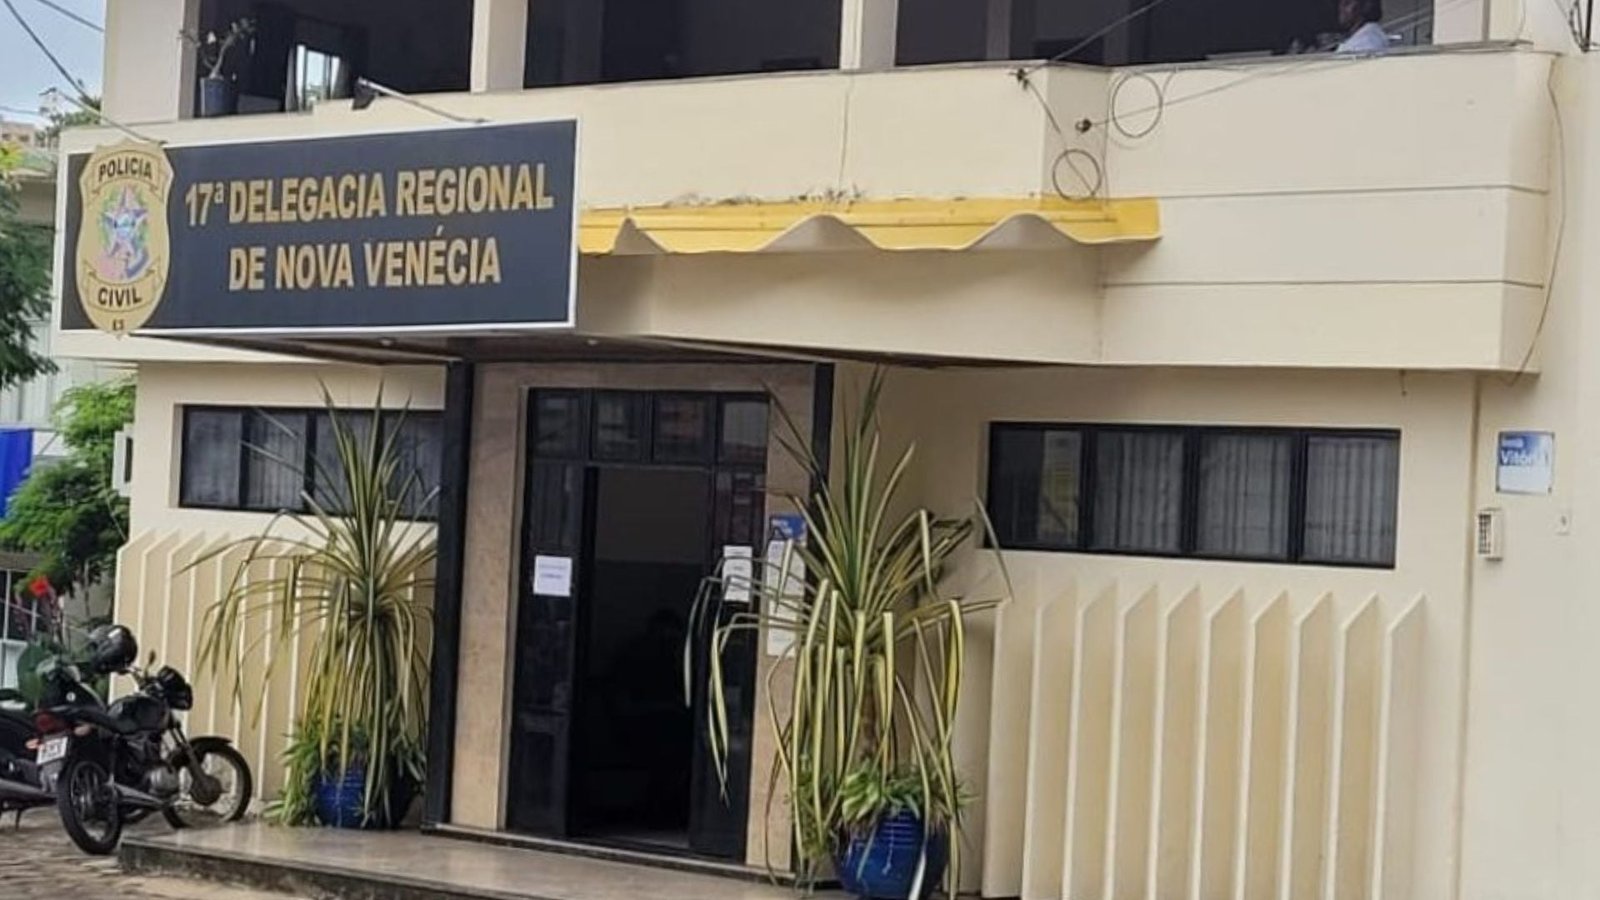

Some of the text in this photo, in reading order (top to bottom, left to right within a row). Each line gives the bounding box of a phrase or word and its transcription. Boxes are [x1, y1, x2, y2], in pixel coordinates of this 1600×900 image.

[229, 173, 387, 223] DELEGACIA
[396, 163, 554, 215] REGIONAL
[229, 225, 501, 290] DE NOVA VENÉCIA
[98, 287, 142, 307] CIVIL
